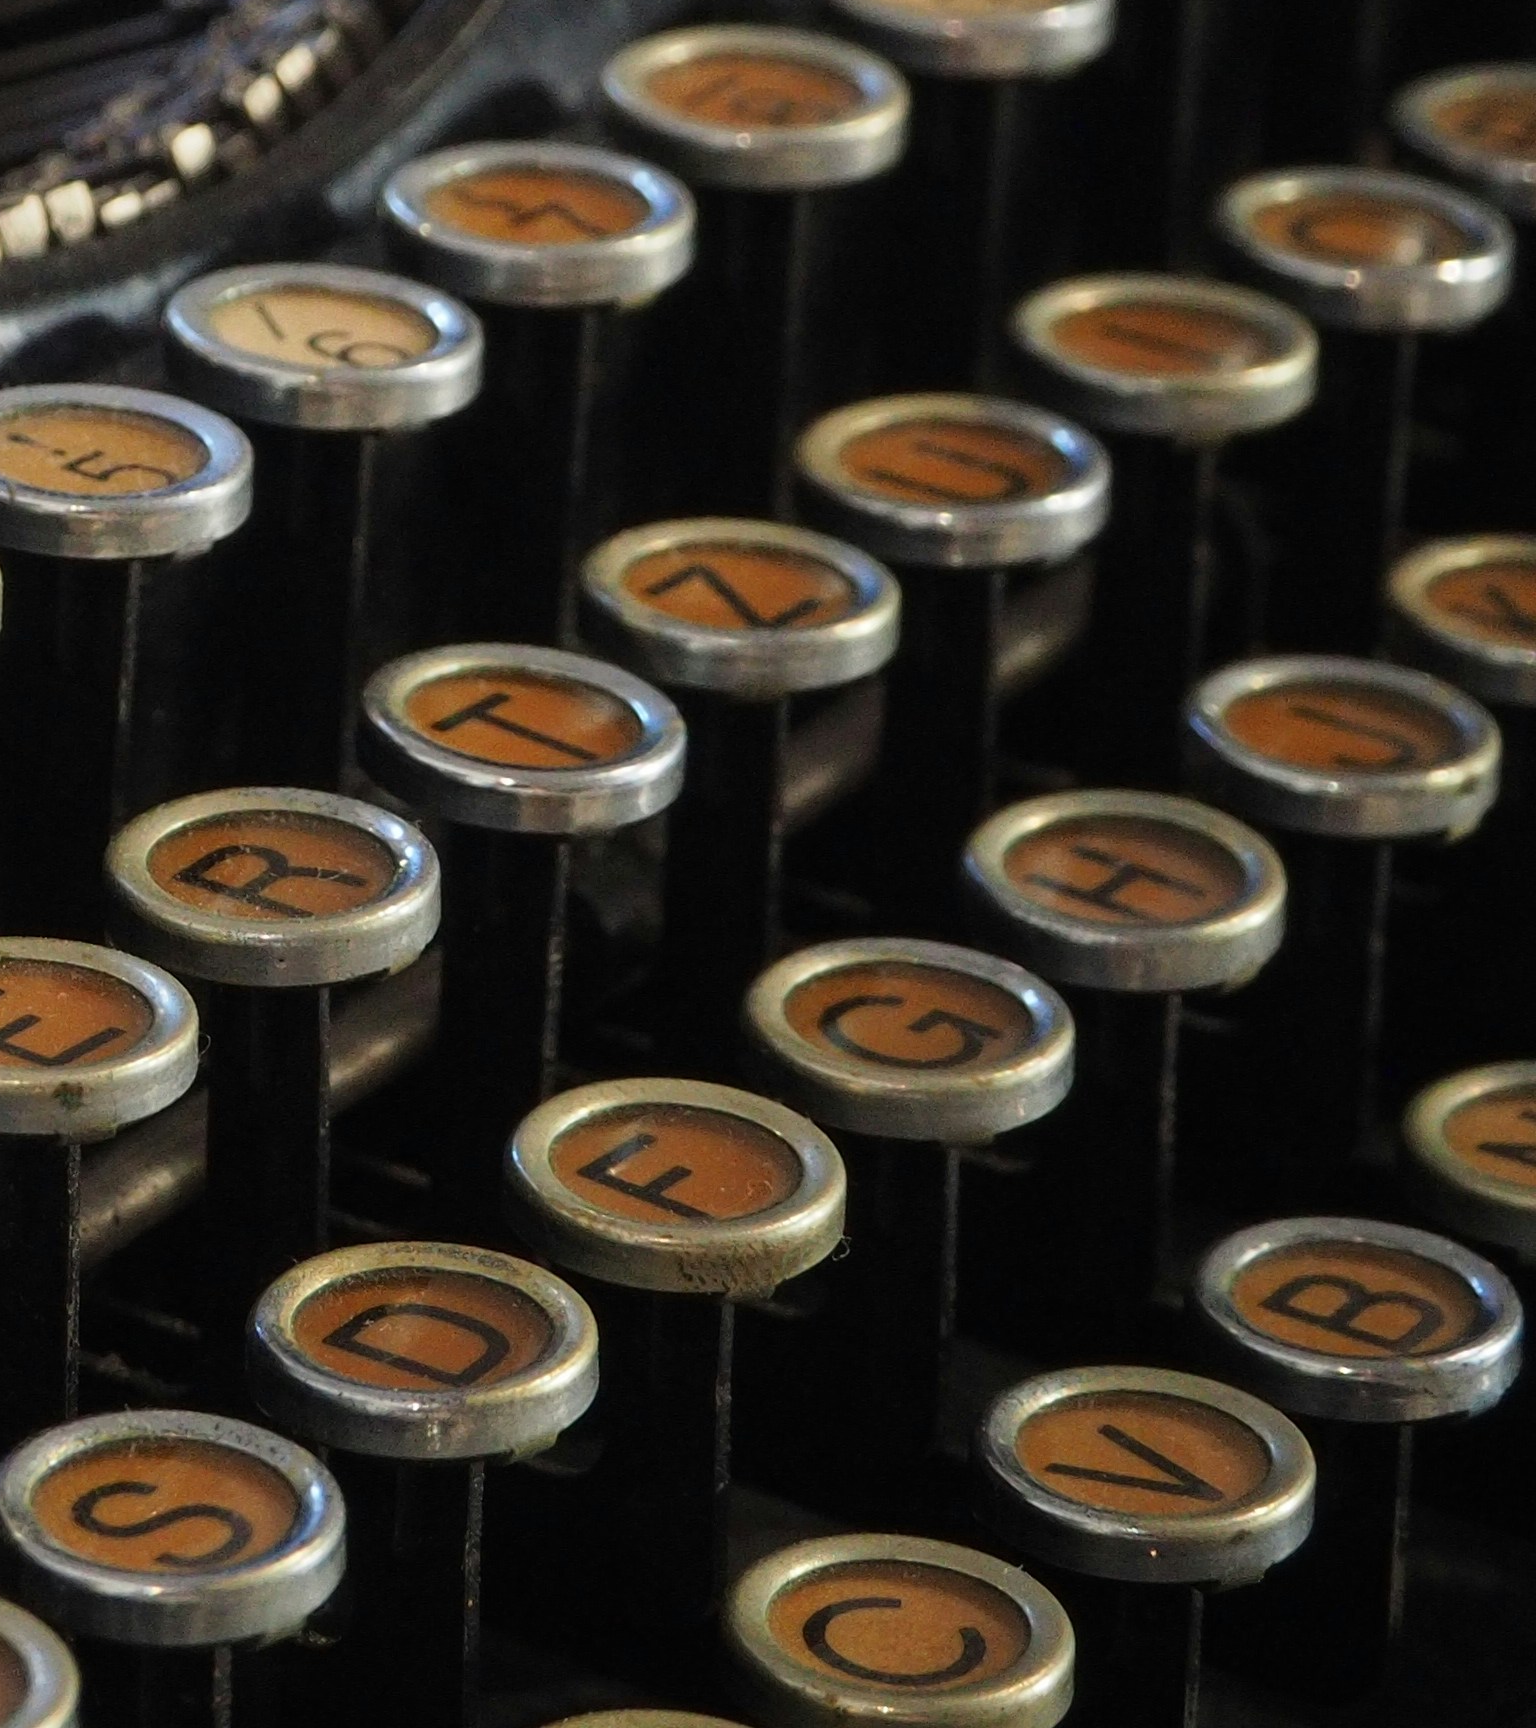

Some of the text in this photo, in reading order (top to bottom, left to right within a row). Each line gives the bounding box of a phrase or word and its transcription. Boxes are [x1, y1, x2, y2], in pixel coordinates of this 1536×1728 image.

[62, 449, 178, 486] 5
[430, 691, 600, 760] T
[172, 842, 368, 920] R
[1024, 844, 1206, 924] H
[816, 992, 1002, 1070] G
[576, 1132, 720, 1224] F
[321, 1302, 512, 1388] D
[1256, 1273, 1442, 1356] B
[1042, 1424, 1226, 1504] V
[70, 1480, 254, 1568] S
[802, 1596, 988, 1686] C
